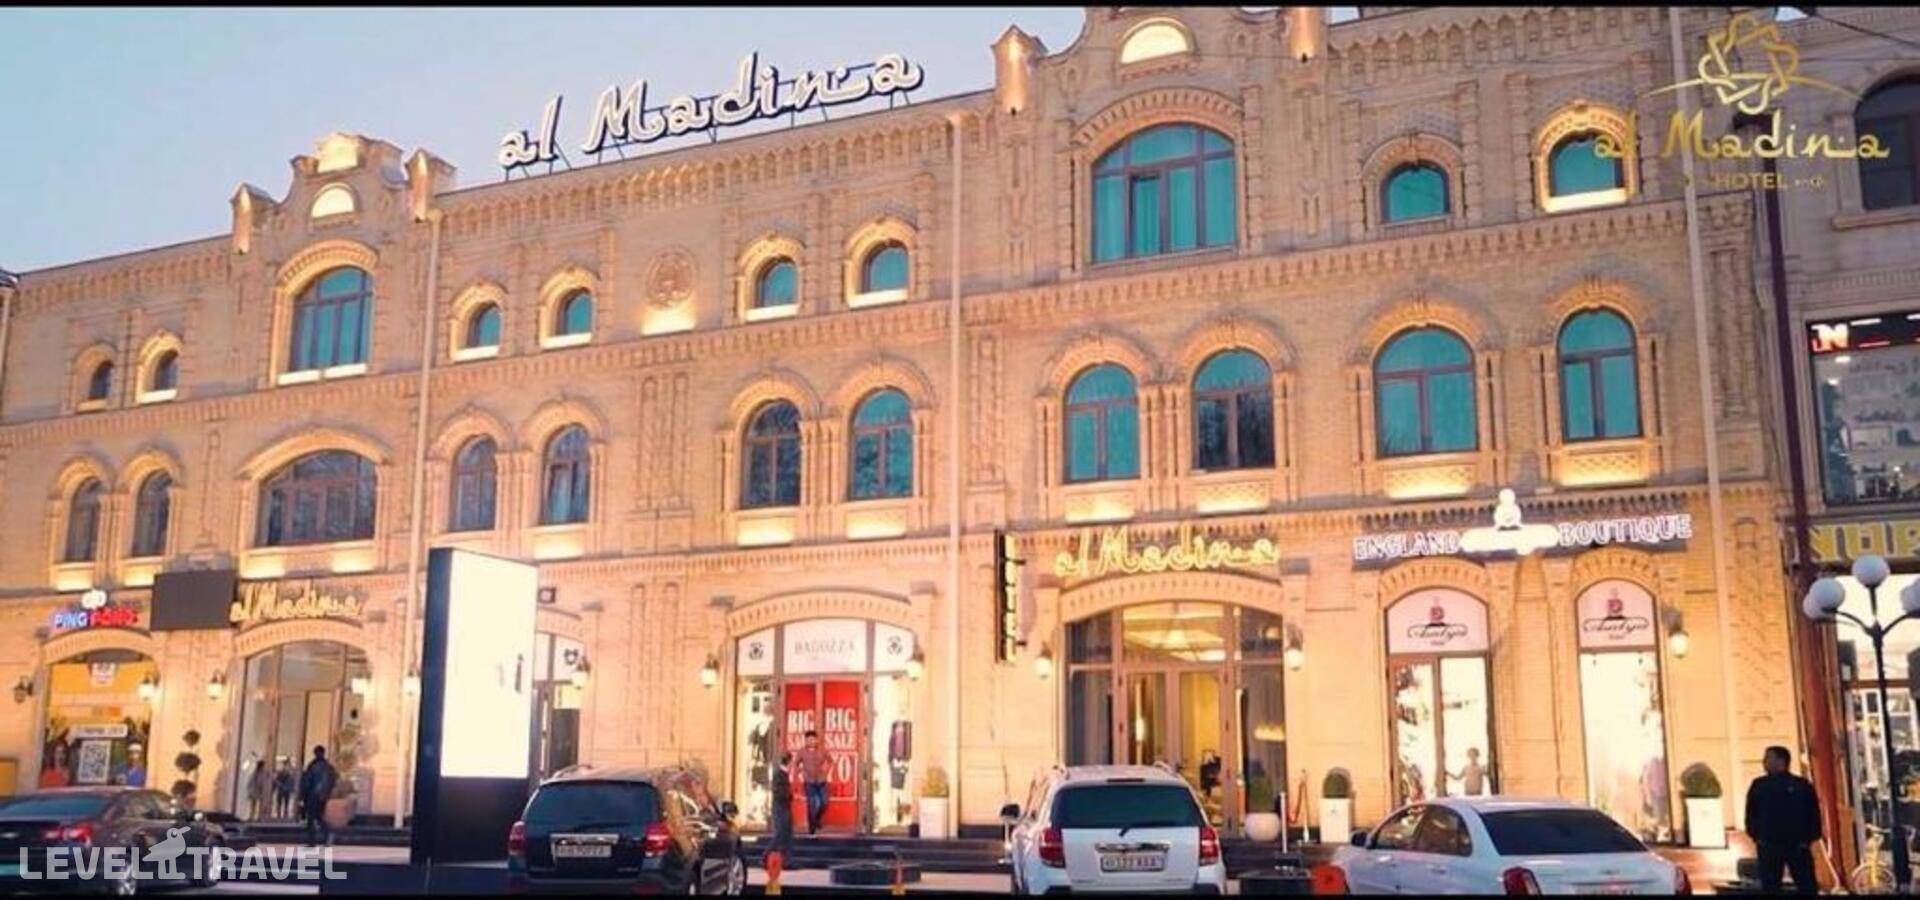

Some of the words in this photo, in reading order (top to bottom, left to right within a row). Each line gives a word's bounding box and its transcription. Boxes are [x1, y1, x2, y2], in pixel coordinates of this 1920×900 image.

[497, 93, 562, 168] al
[582, 50, 924, 155] Madina
[1558, 513, 1693, 548] BOUTIQUE
[1353, 529, 1462, 561] ENGLAND
[54, 612, 89, 630] PING
[787, 710, 815, 733] BIG
[825, 708, 857, 732] BIG
[824, 732, 857, 751] SALE
